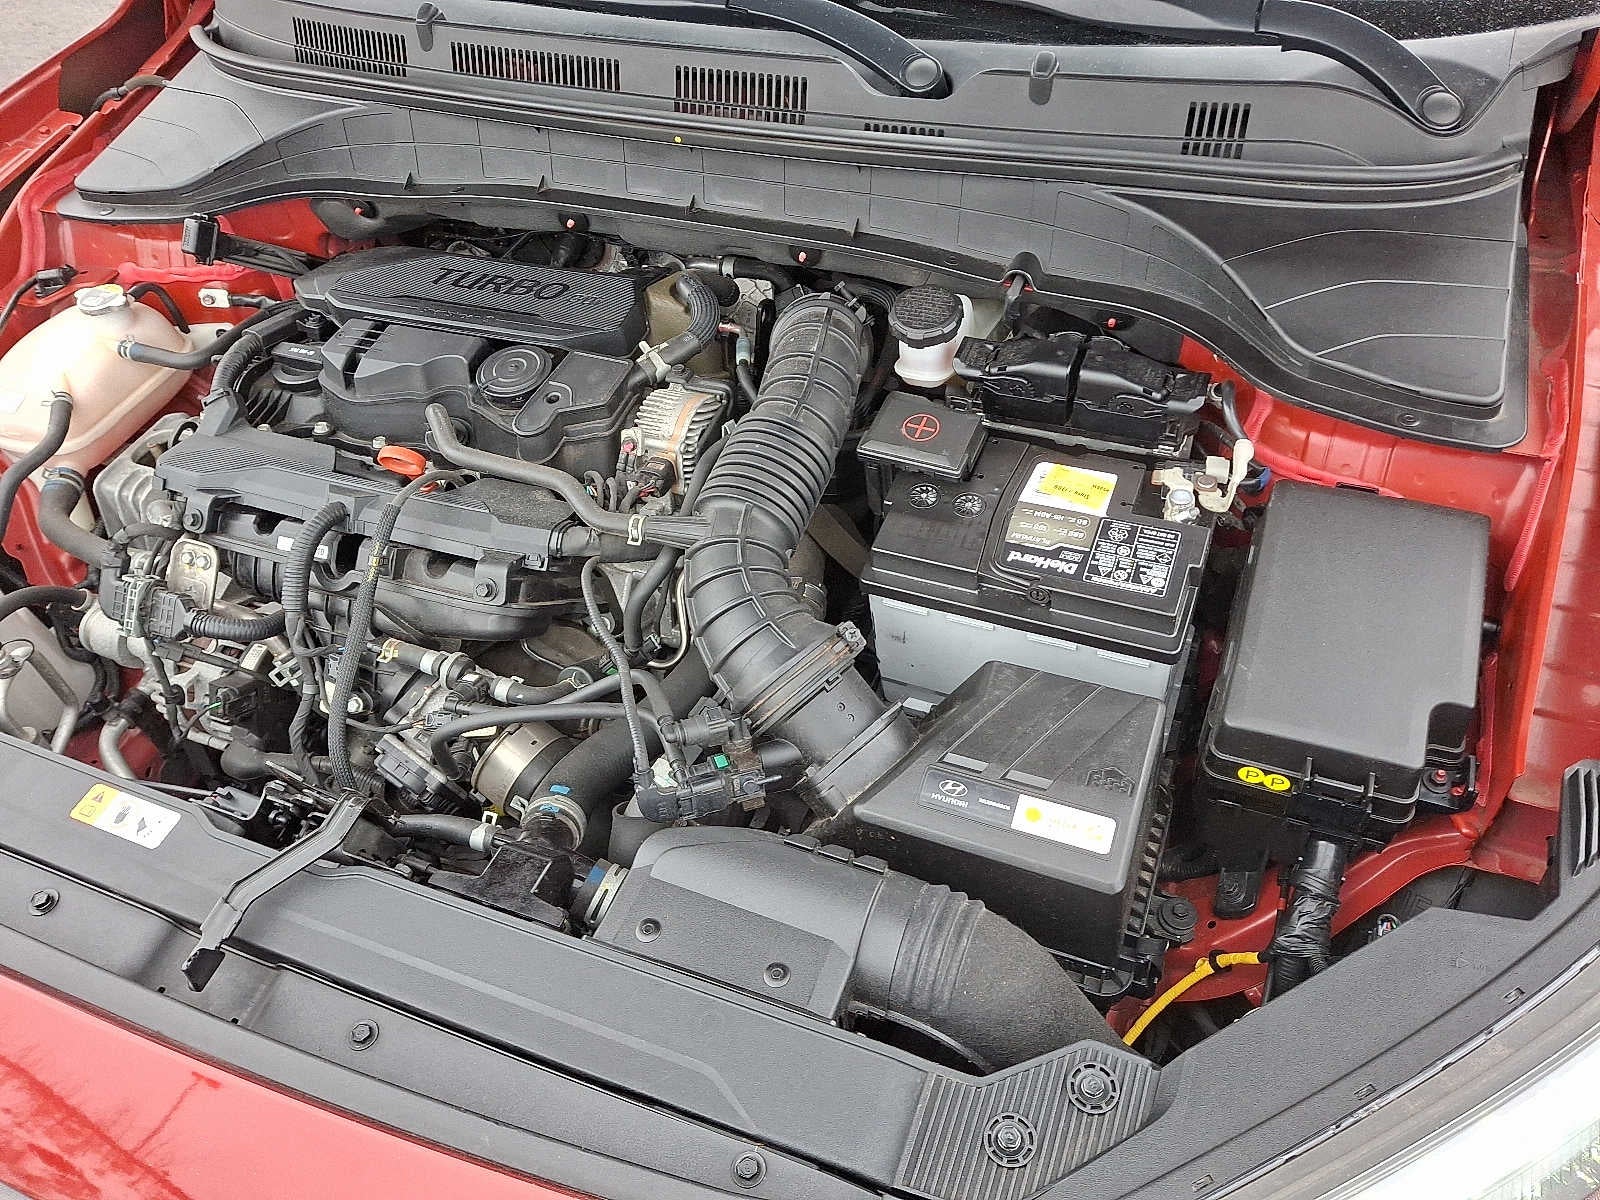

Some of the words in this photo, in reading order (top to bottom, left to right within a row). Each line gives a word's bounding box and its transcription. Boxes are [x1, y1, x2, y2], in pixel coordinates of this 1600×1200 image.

[432, 267, 570, 301] TURBO
[1006, 550, 1079, 575] DieHard
[1246, 770, 1259, 779] P
[1270, 778, 1285, 787] P
[931, 793, 969, 808] HYUNDAI
